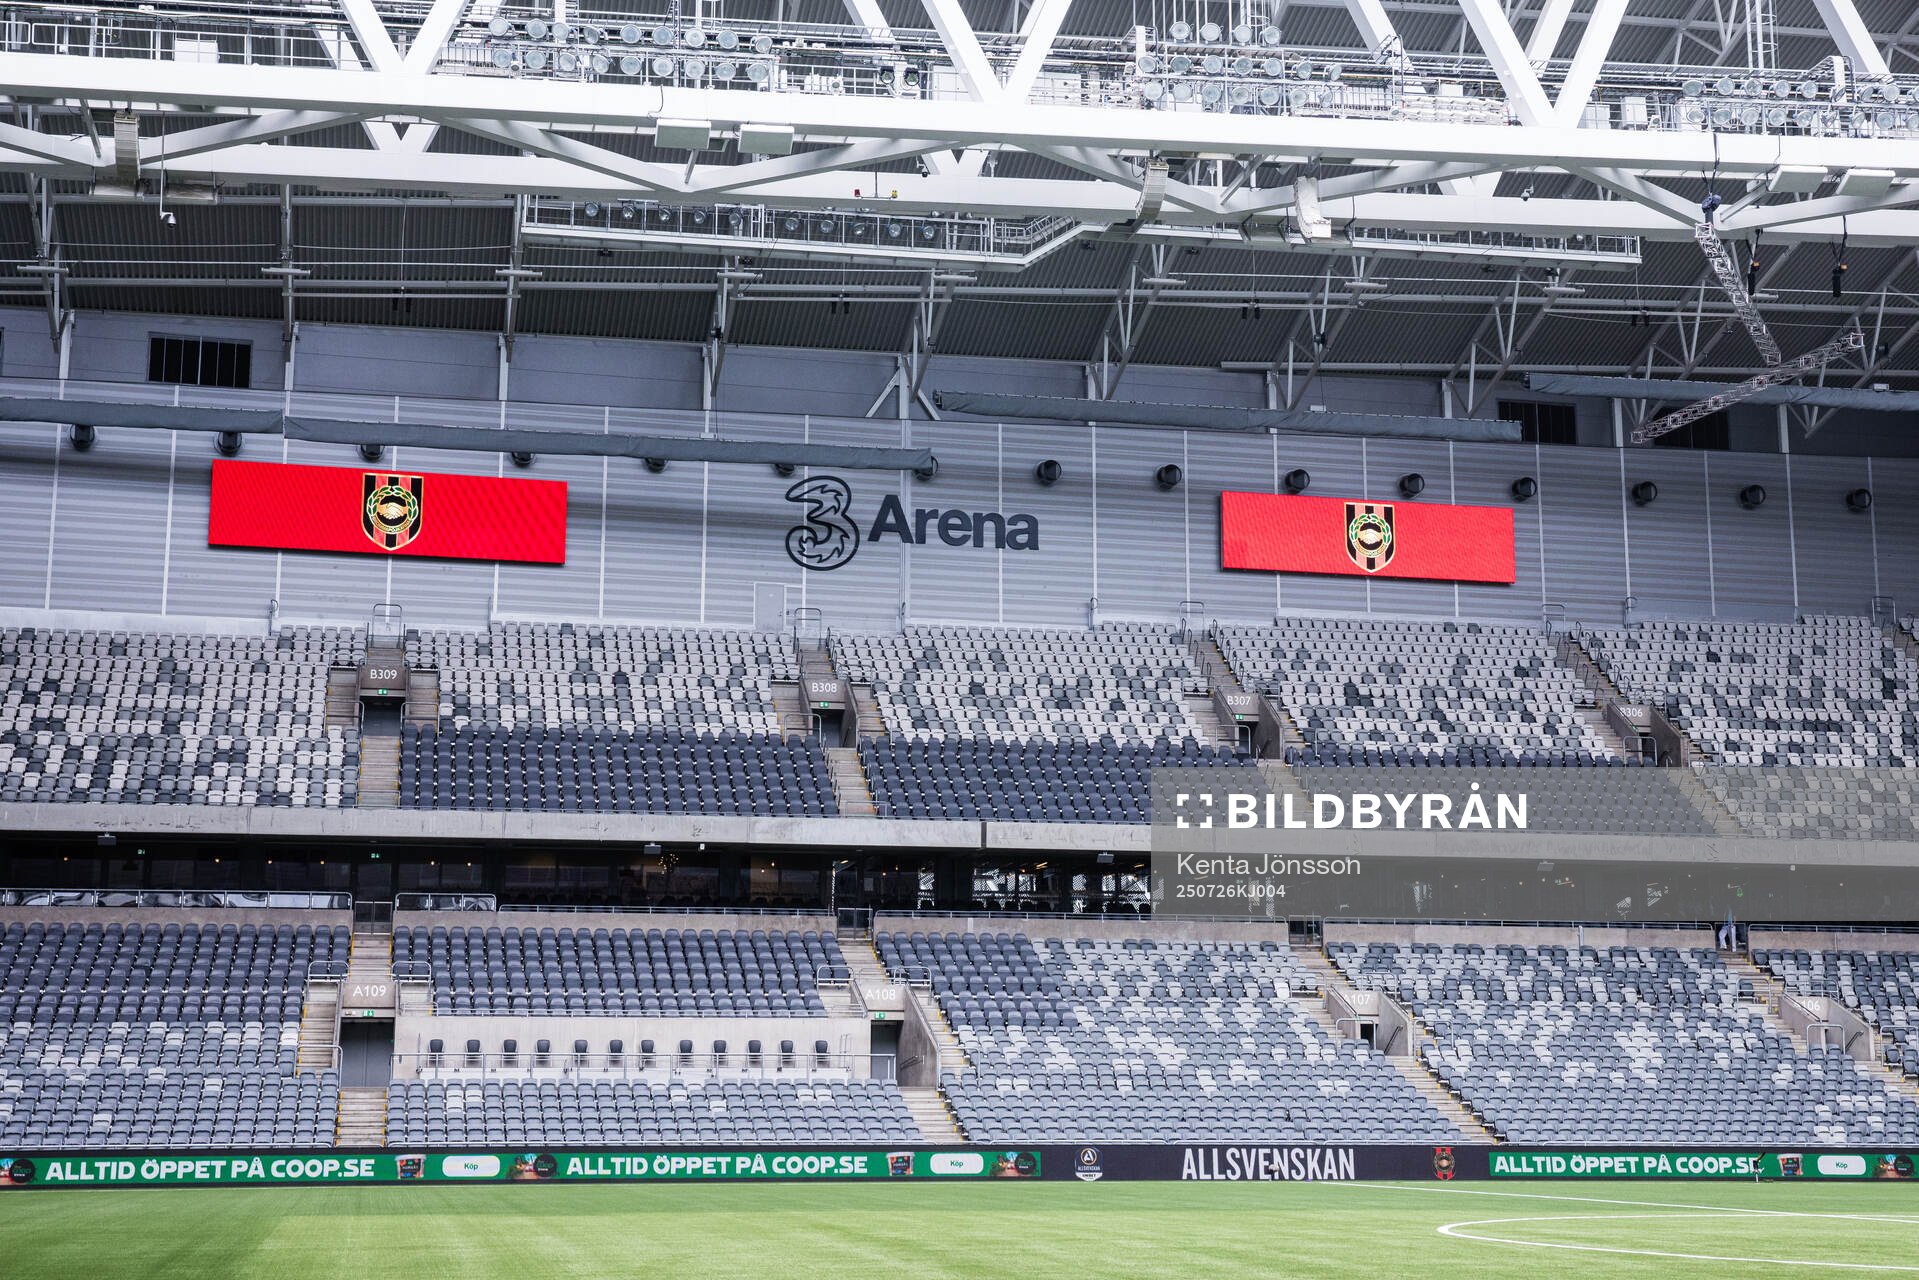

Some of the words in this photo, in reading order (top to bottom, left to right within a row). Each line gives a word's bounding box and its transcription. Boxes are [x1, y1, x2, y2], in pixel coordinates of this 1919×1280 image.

[867, 494, 1039, 551] Arena
[370, 669, 397, 679] B309
[811, 682, 837, 693] B308
[1227, 695, 1251, 705] B307
[352, 984, 386, 997] A109
[864, 989, 896, 1001] A108
[45, 1159, 136, 1181] ALLTID
[141, 1158, 227, 1179] ÖPPET
[231, 1157, 266, 1179] PÅ
[271, 1158, 375, 1178] COOP.SE
[463, 1161, 479, 1171] Köp
[566, 1157, 649, 1176] ALLTID
[653, 1155, 731, 1175] ÖPPET
[736, 1153, 768, 1174] PÅ
[771, 1156, 868, 1174] COOP.SE
[949, 1160, 964, 1169] Köp
[1181, 1147, 1356, 1180] ALLSVENSKAN
[1494, 1156, 1567, 1174] ALLTID
[1570, 1155, 1639, 1174] ÖPPET
[1642, 1154, 1673, 1173] PÅ
